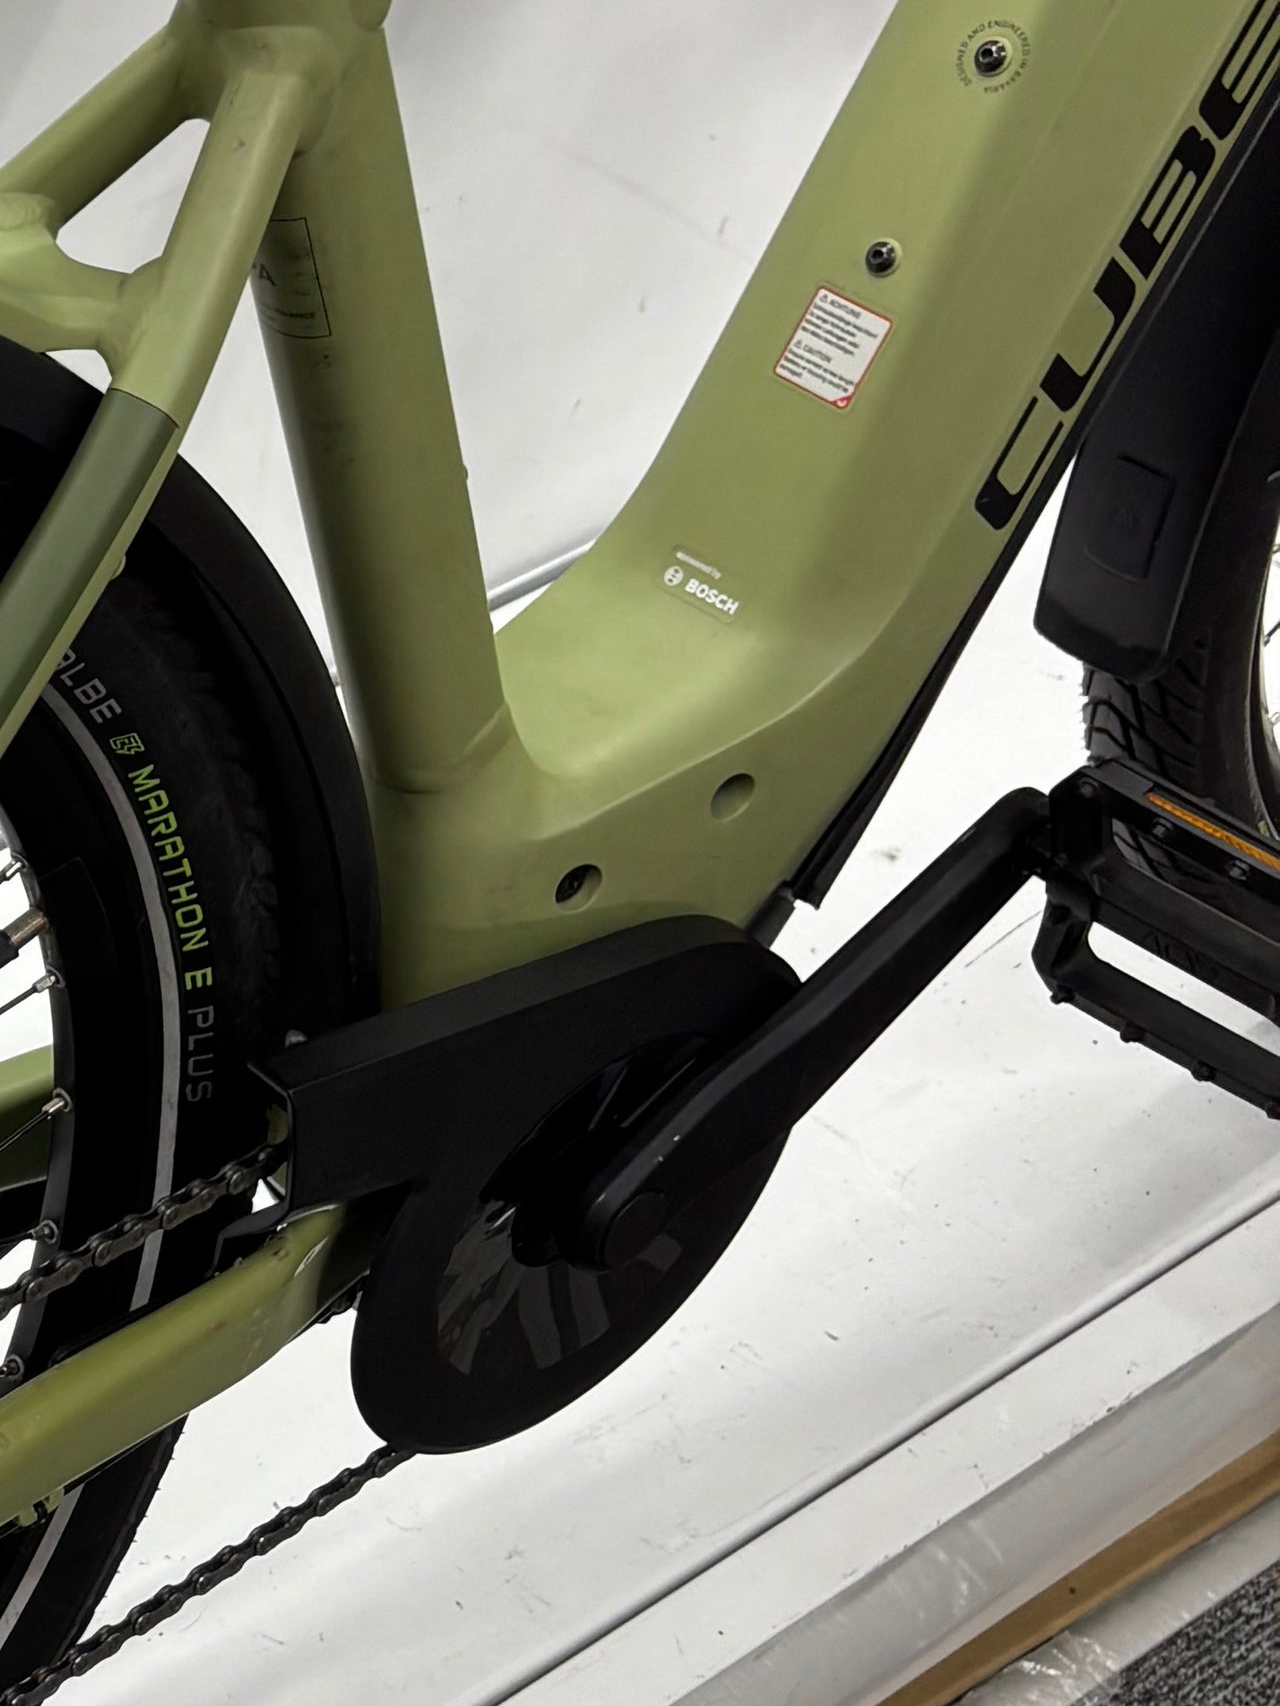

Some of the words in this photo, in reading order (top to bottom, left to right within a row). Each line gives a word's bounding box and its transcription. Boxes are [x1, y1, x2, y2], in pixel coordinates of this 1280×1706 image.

[684, 578, 740, 615] BOSCH
[127, 763, 209, 953] MARATHON
[184, 966, 213, 991] E
[185, 1004, 215, 1103] PLUS
